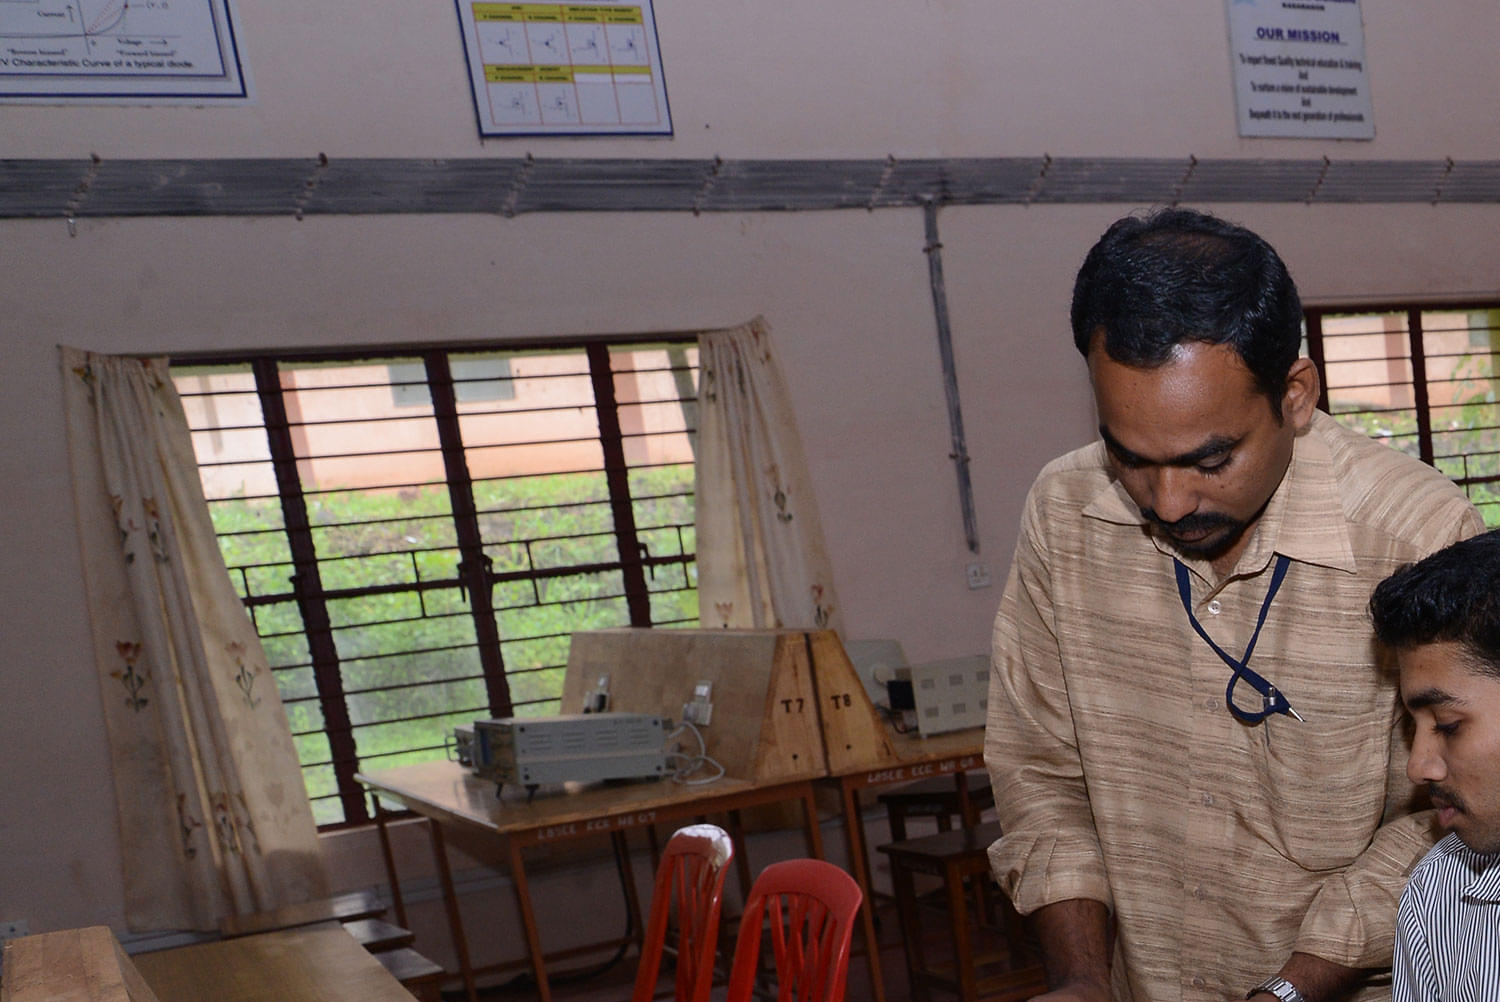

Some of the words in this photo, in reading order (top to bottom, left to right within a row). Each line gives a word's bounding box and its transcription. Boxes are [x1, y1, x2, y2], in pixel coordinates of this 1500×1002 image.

[1256, 26, 1284, 40] OUR
[1287, 29, 1340, 43] MISSION
[82, 58, 111, 67] Curve
[781, 698, 804, 713] T7
[830, 693, 852, 710] T8
[586, 819, 610, 831] ECE
